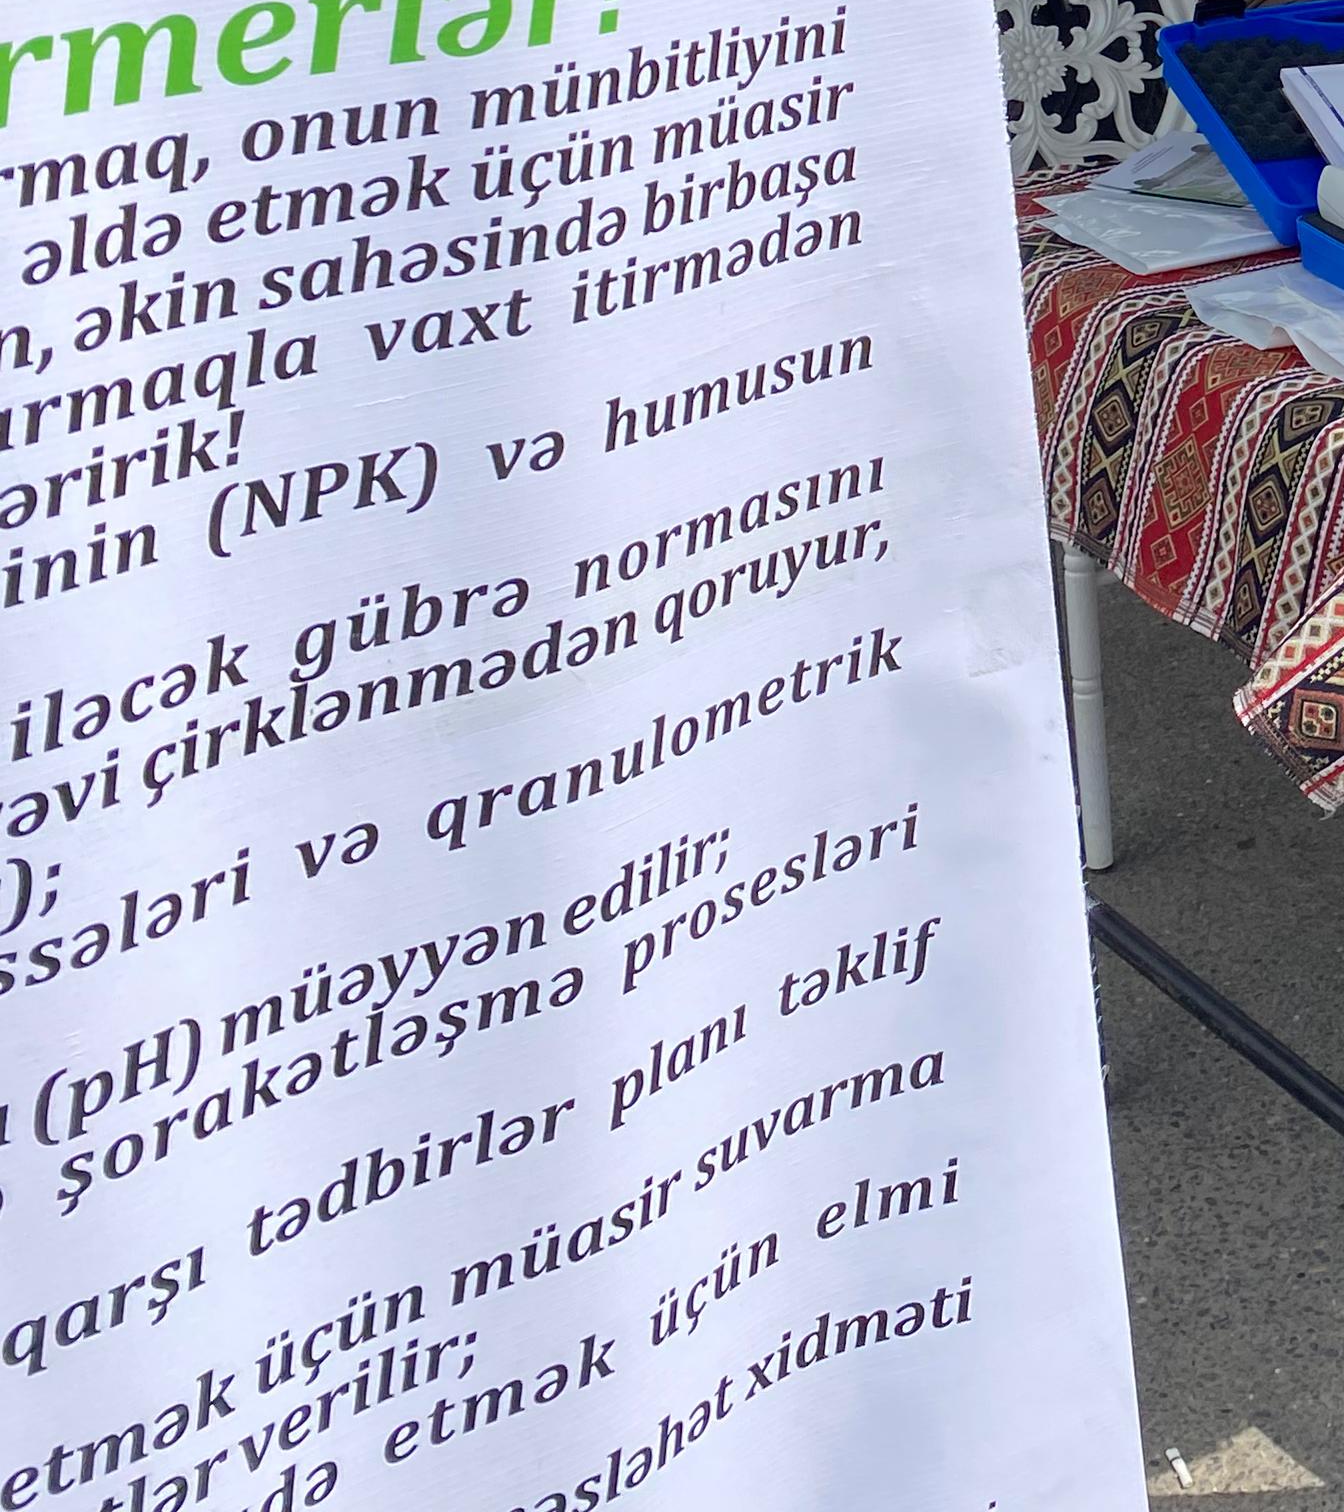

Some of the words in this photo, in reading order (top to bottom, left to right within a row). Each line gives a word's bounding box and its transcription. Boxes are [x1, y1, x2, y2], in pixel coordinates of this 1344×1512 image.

[22, 202, 183, 286] əldə
[207, 153, 450, 244] etmək
[471, 129, 634, 209] üçün
[652, 75, 854, 165] müasir
[242, 93, 439, 163] onun
[471, 5, 847, 130] münbitliyini
[74, 271, 239, 354] əkin
[258, 197, 628, 310] sahəsində
[642, 145, 857, 237] birbaşa
[365, 288, 532, 362] vaxt
[572, 209, 862, 325] itirmədən
[2, 521, 159, 609] inin
[208, 441, 438, 558] (NPK)
[486, 429, 565, 481] və
[605, 334, 873, 453] humusun
[10, 634, 249, 762] iləcək
[290, 577, 530, 684] gübrə
[574, 456, 884, 600] normasını
[0, 747, 120, 838] əvi
[142, 621, 638, 809] çirklənmədən
[654, 519, 889, 645] qoruyur,
[295, 822, 379, 879] və
[427, 627, 903, 852] qranulometrik
[34, 1018, 201, 1147] (pH)
[221, 910, 546, 1056] müəyyən
[562, 827, 731, 936] edilir;
[57, 965, 584, 1217] şorakətləşmə
[622, 803, 919, 996] prosesləri
[0, 1368, 237, 1512] etmək
[255, 1284, 426, 1395] üçün
[450, 1169, 683, 1307] müasir
[694, 1050, 945, 1192] suvarma
[2, 1245, 207, 1377] qarşı
[247, 1097, 576, 1257] tədbirlər
[609, 1003, 747, 1132] planı
[778, 917, 942, 1018] təklif
[238, 1331, 478, 1473] verilir;
[242, 1461, 338, 1512] də
[383, 1332, 616, 1465] etmək
[649, 1231, 780, 1349] üçün
[816, 1156, 960, 1240] elmi
[508, 1374, 735, 1512] əsləhət
[744, 1275, 974, 1401] xidməti
